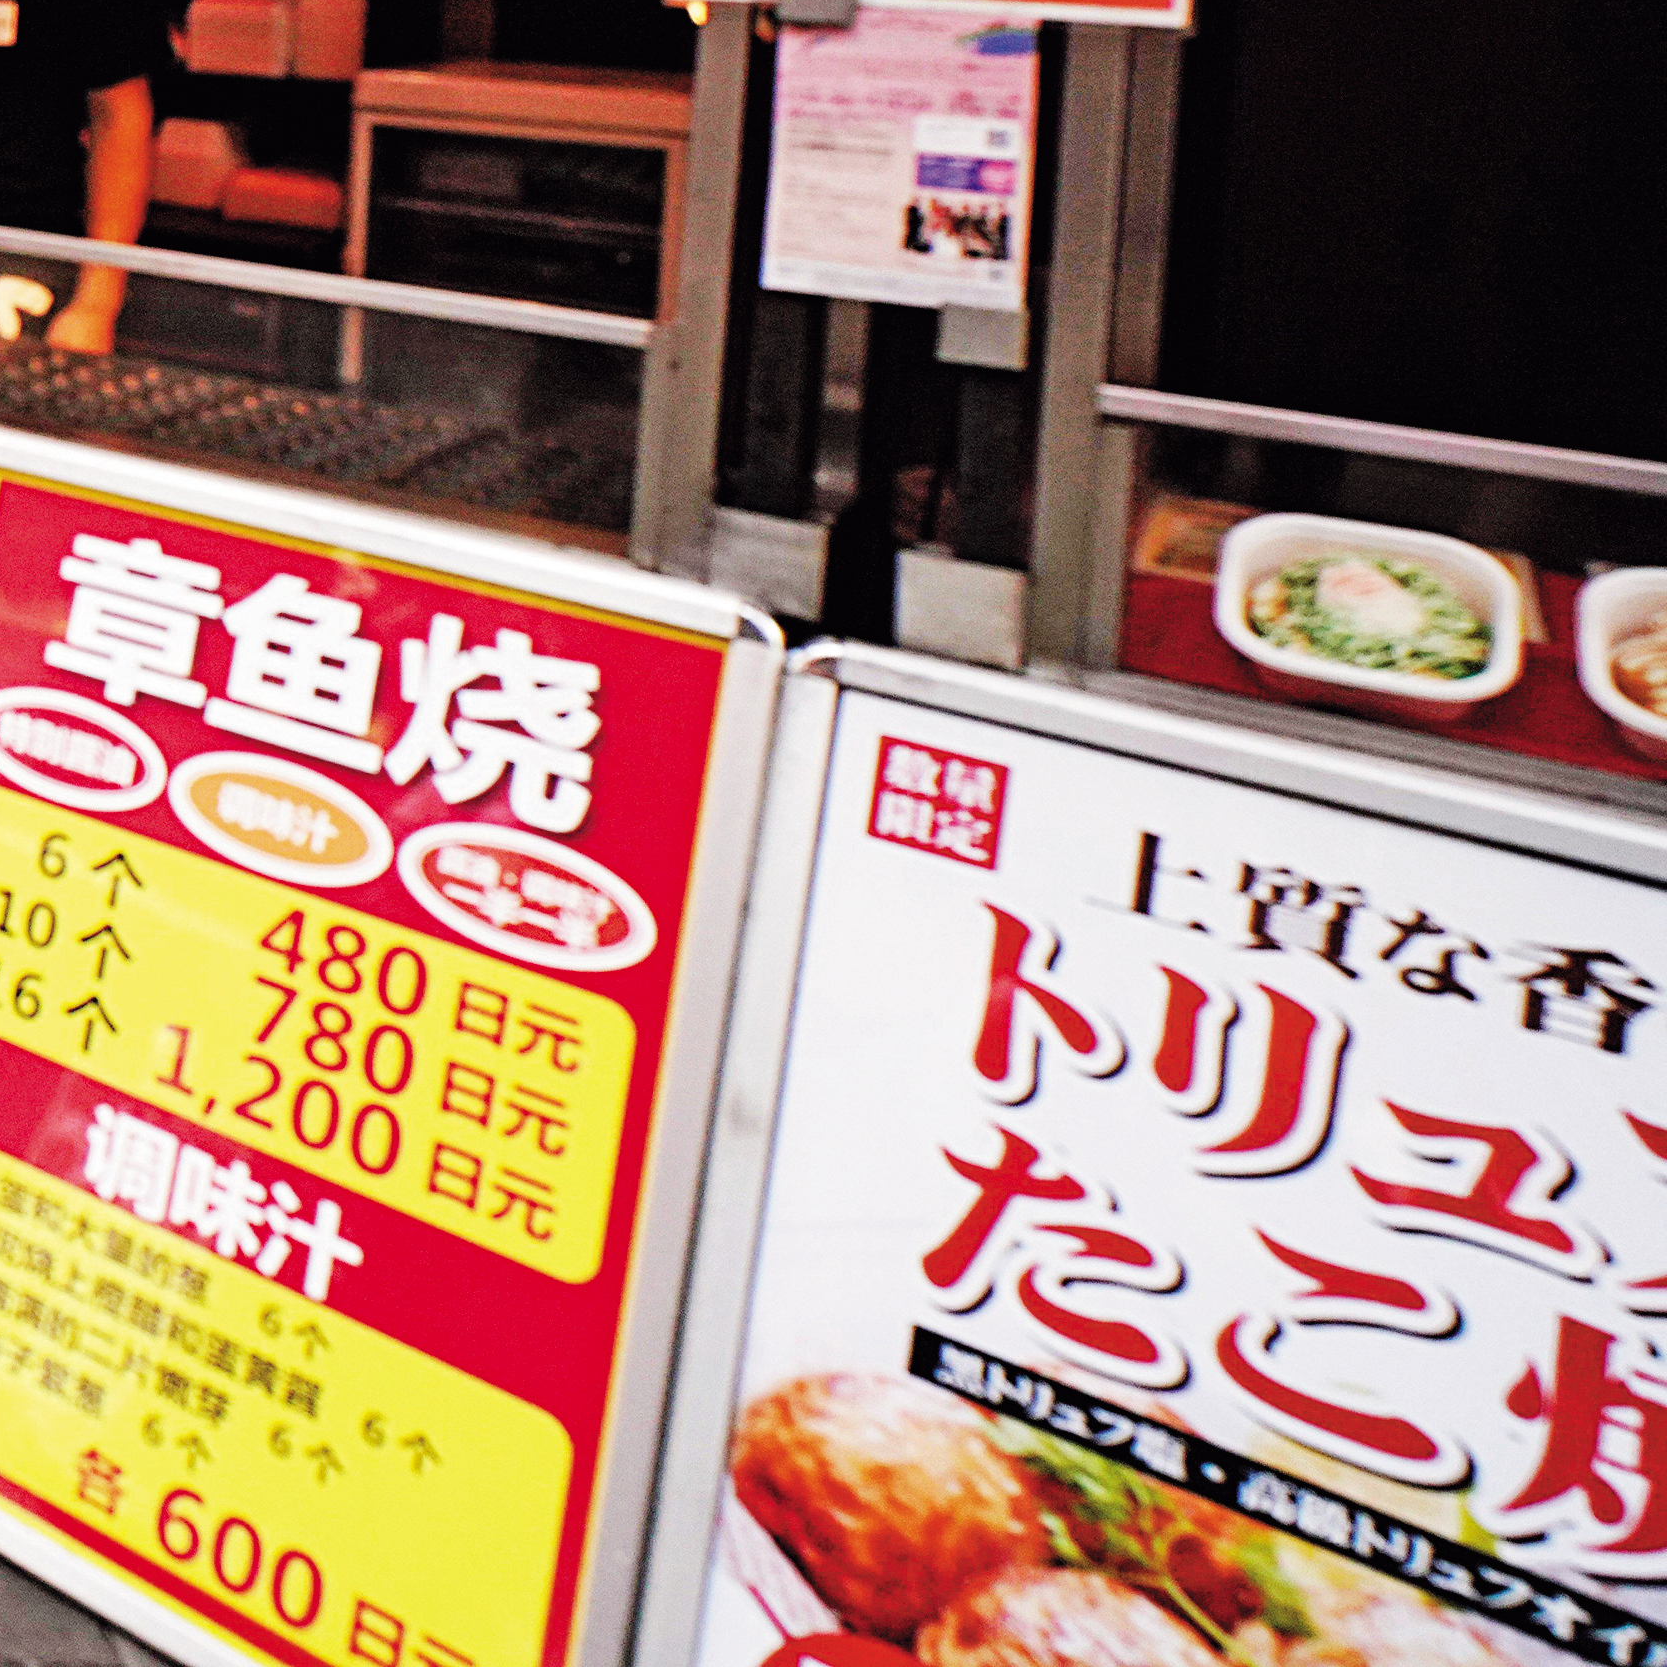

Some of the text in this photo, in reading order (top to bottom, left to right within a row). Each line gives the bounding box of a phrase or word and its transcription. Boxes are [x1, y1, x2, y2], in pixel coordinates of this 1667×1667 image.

[43, 531, 603, 835] 章鱼烧
[39, 831, 584, 1075] 6 个 480 日元
[79, 924, 134, 979] 个
[254, 973, 415, 1097] 780
[440, 1061, 570, 1157] 日元
[1087, 830, 1662, 1054] 上質な香
[66, 995, 118, 1052] 个
[155, 1021, 402, 1178] 1,200
[427, 1142, 556, 1243] 日元
[84, 1102, 365, 1302] 调味汁
[257, 1301, 283, 1339] 6
[140, 1410, 165, 1448] 6
[267, 1420, 293, 1459] 6
[360, 1409, 388, 1448] 6
[156, 1486, 323, 1631] 600
